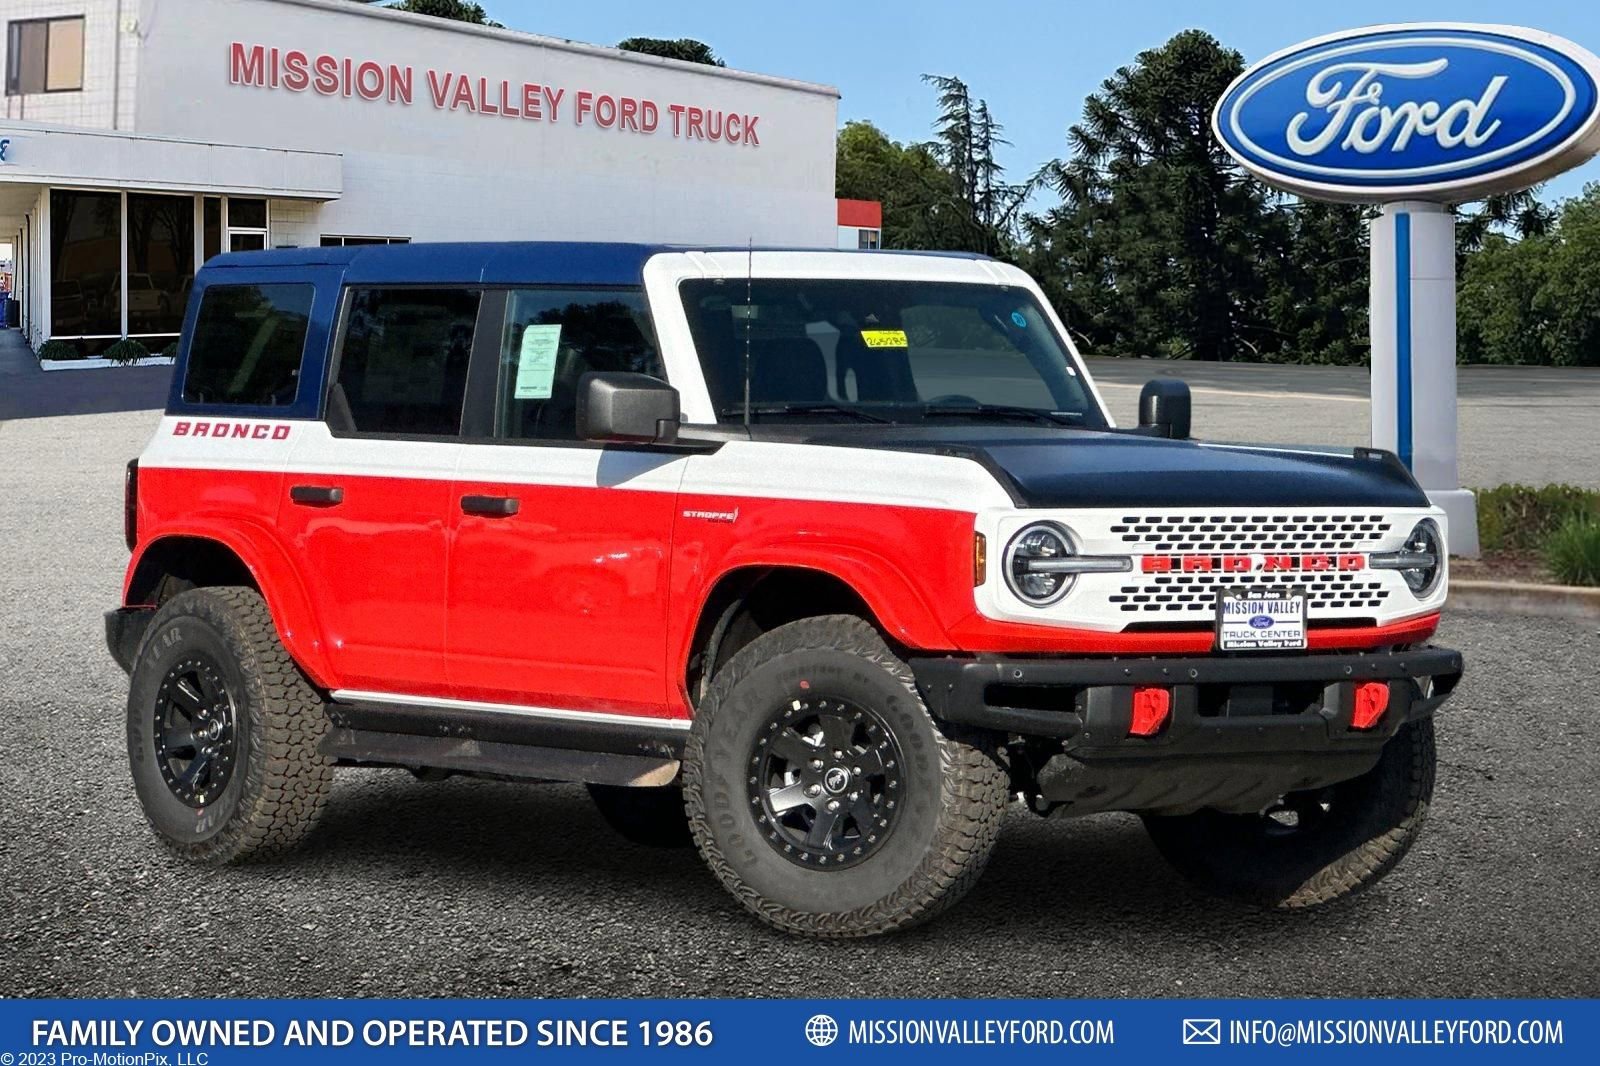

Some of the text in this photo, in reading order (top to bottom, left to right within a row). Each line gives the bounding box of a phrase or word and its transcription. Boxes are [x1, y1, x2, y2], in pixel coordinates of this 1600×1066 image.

[230, 42, 759, 146] MISSION VALLEY FORD TRUCK
[1286, 57, 1509, 156] Ford
[172, 421, 291, 440] BRONCO
[1141, 553, 1365, 575] BRONCO
[1223, 601, 1301, 614] MISSION VALLEY
[1260, 630, 1301, 638] CENTER
[1257, 641, 1282, 649] Valley
